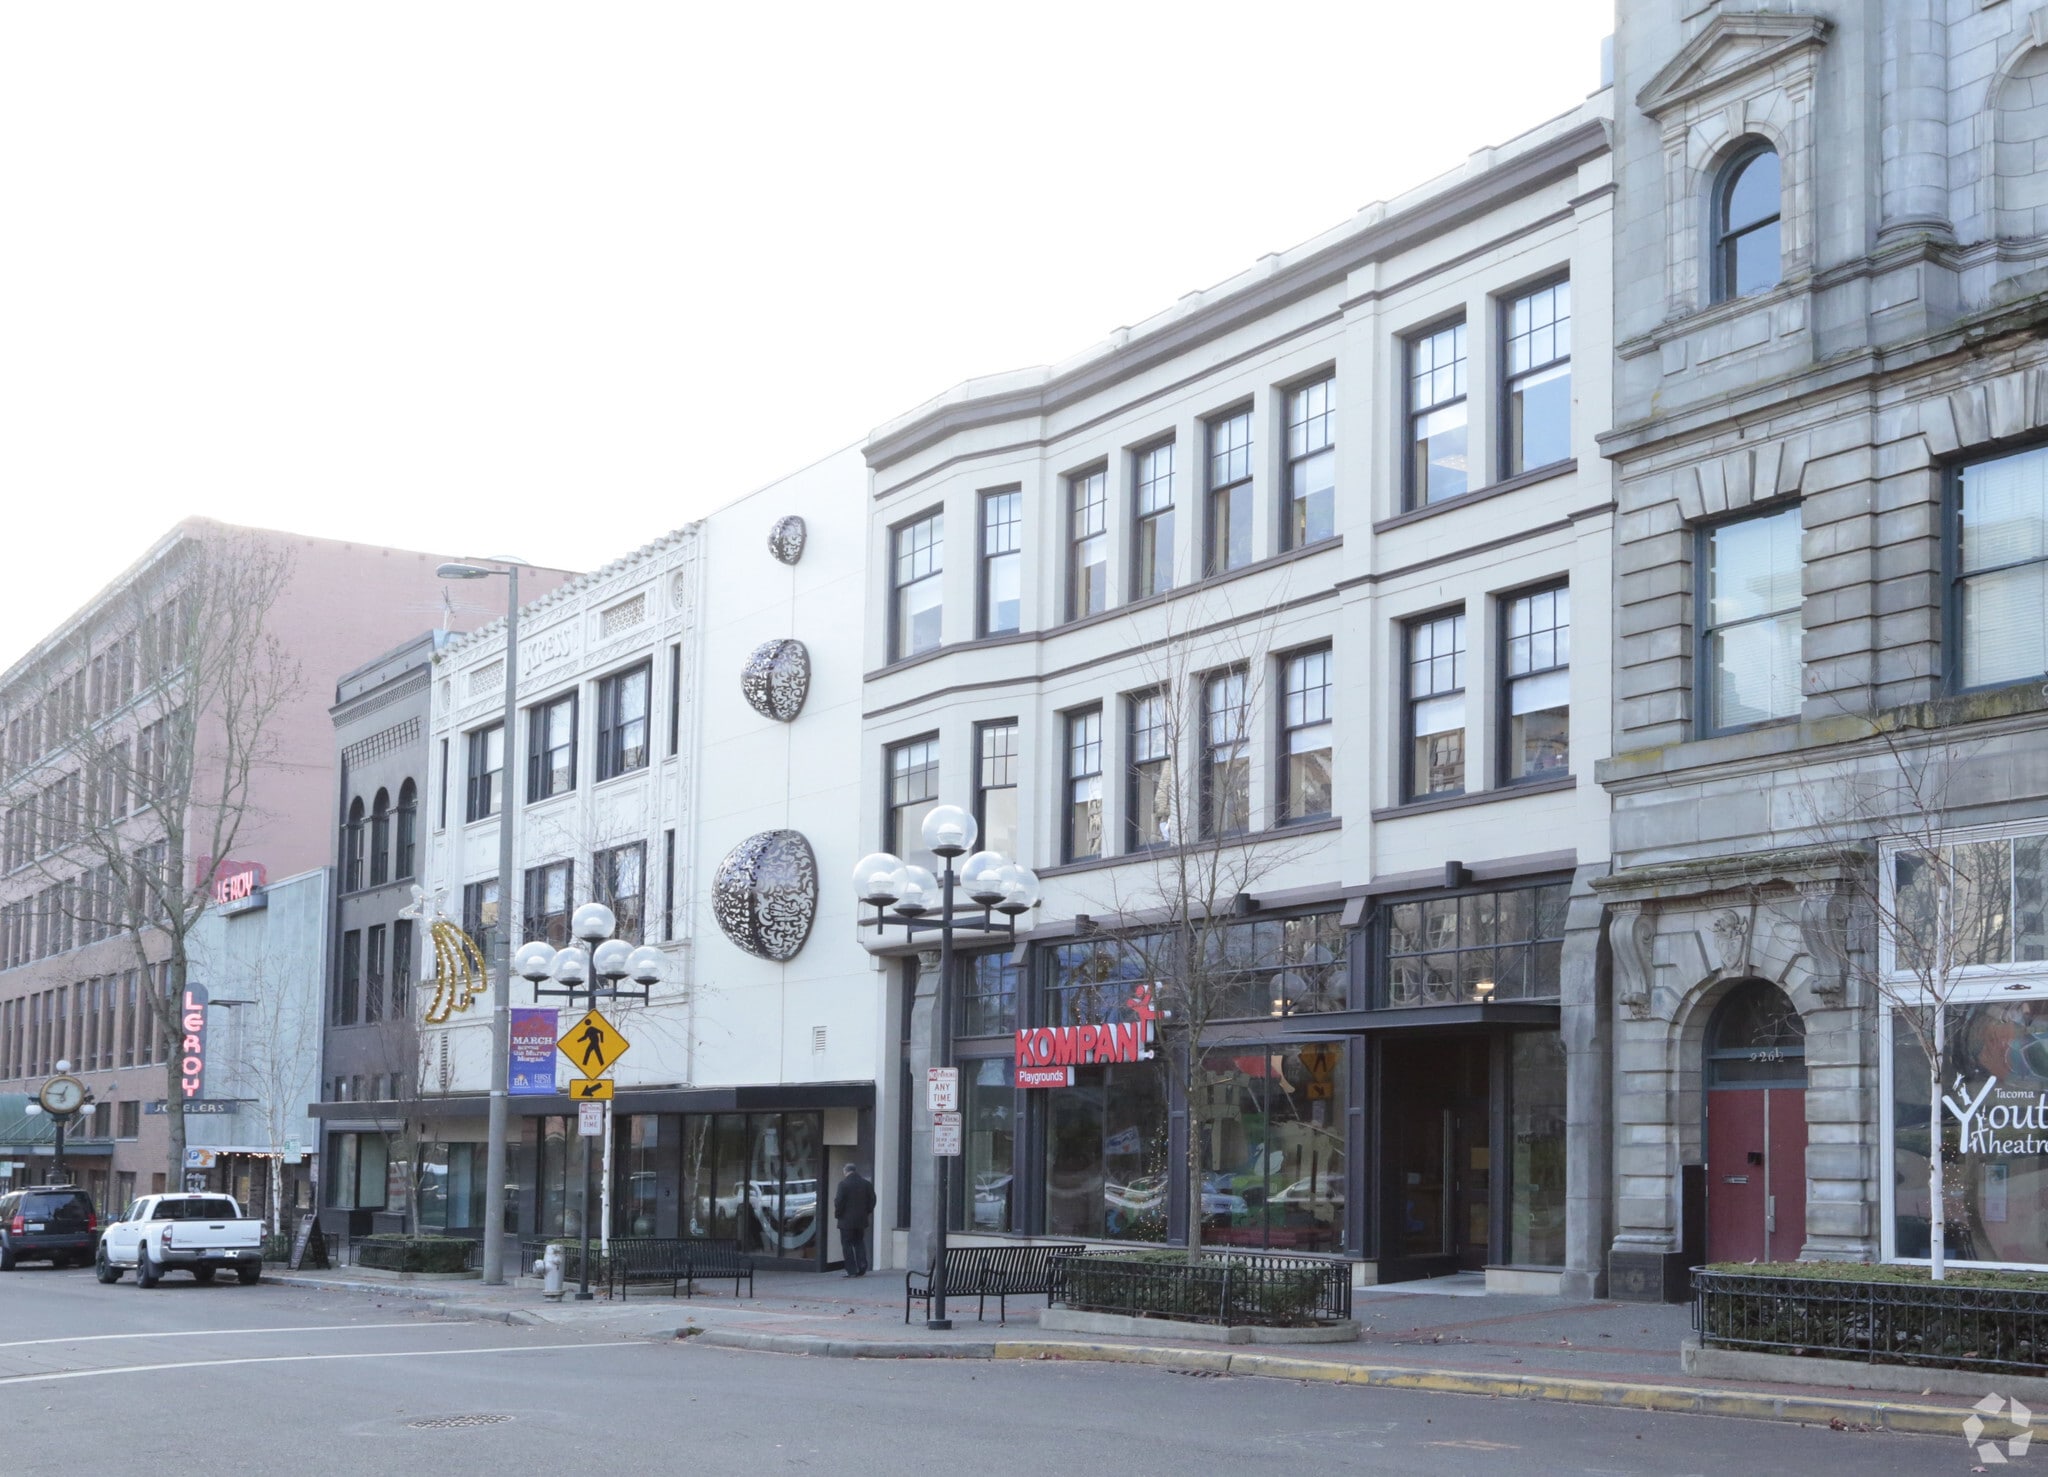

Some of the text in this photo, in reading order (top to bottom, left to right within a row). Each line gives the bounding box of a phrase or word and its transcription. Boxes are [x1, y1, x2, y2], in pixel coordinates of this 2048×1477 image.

[182, 991, 204, 1097] LEROY
[1019, 1070, 1064, 1085] Playgrounds
[935, 1083, 951, 1091] ANY
[1994, 1087, 2035, 1099] Tacoma
[933, 1093, 952, 1102] TIME
